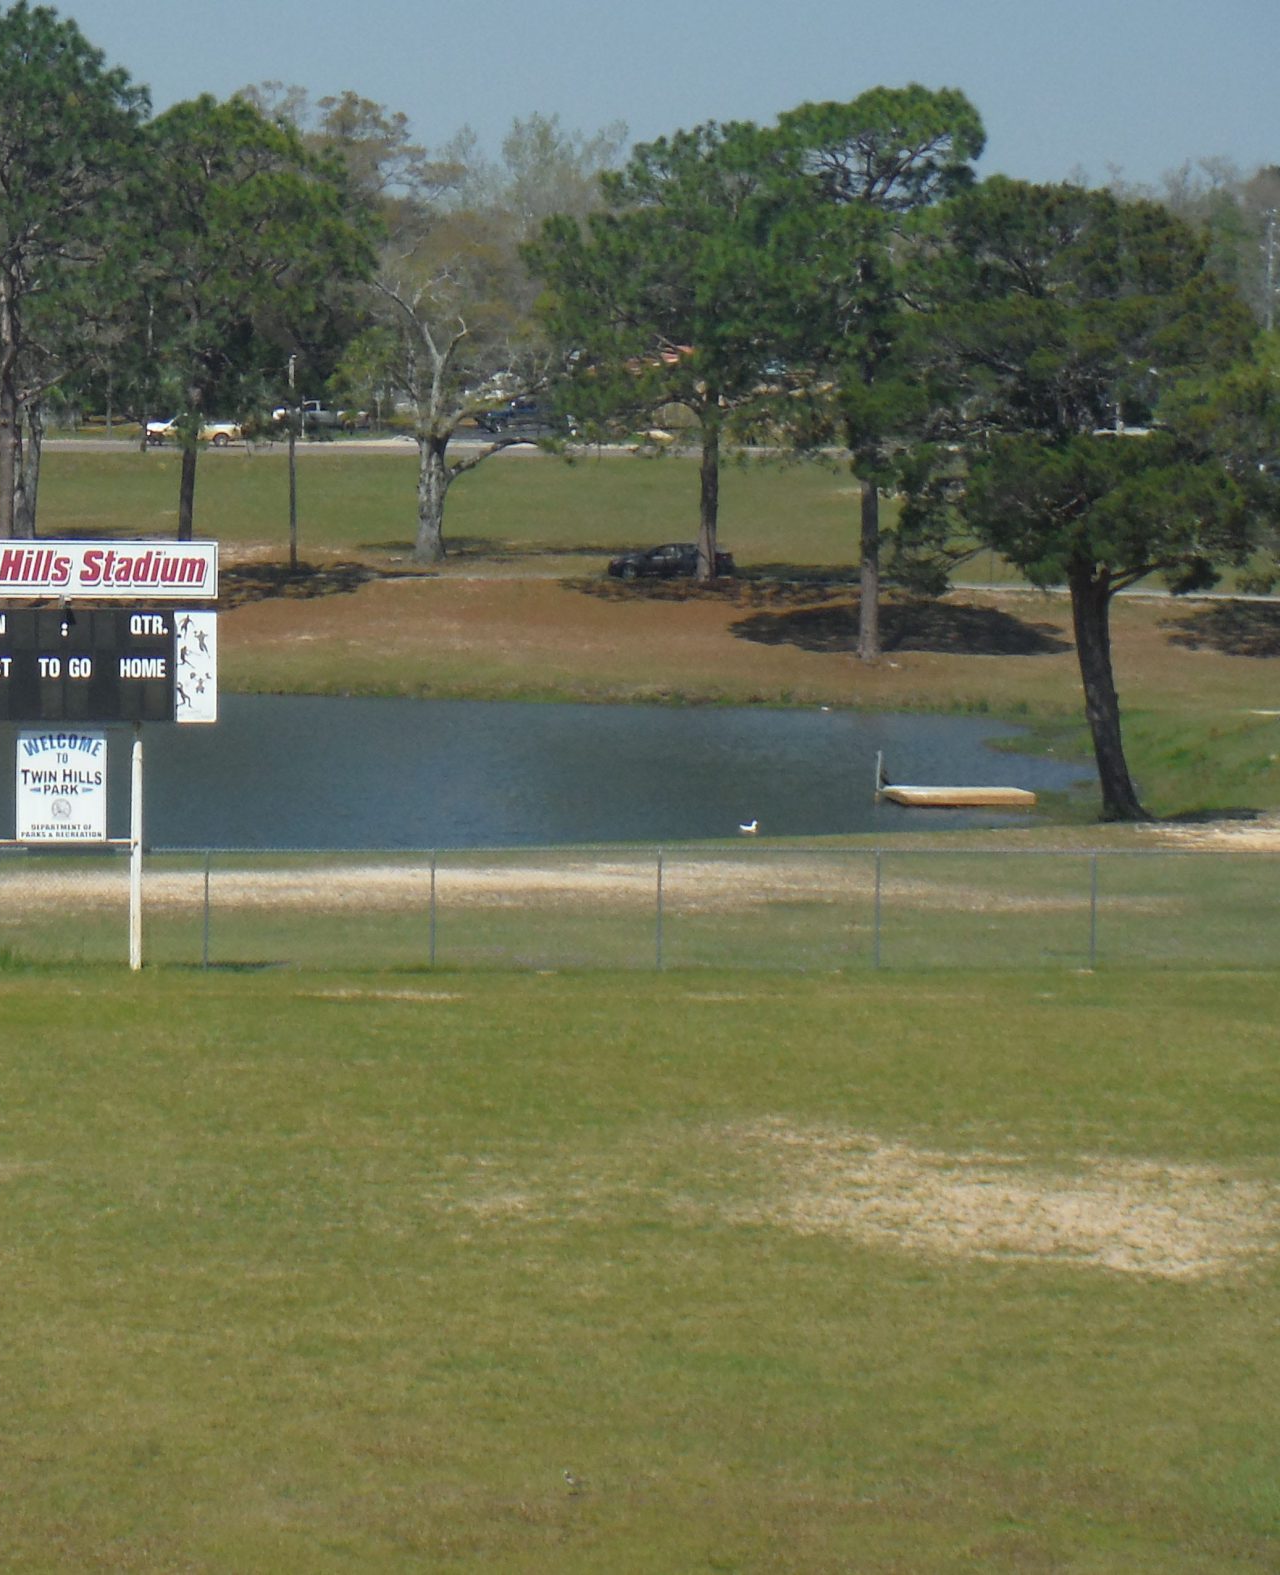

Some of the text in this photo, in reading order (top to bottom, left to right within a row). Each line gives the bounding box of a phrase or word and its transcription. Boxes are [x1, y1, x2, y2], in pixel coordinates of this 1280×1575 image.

[79, 550, 207, 587] Stadium
[130, 615, 168, 635] QTR.
[38, 658, 91, 678] TO GO
[120, 658, 166, 678] HOME
[23, 733, 102, 757] WELCOME
[56, 752, 68, 764] TO
[43, 784, 78, 795] PARK
